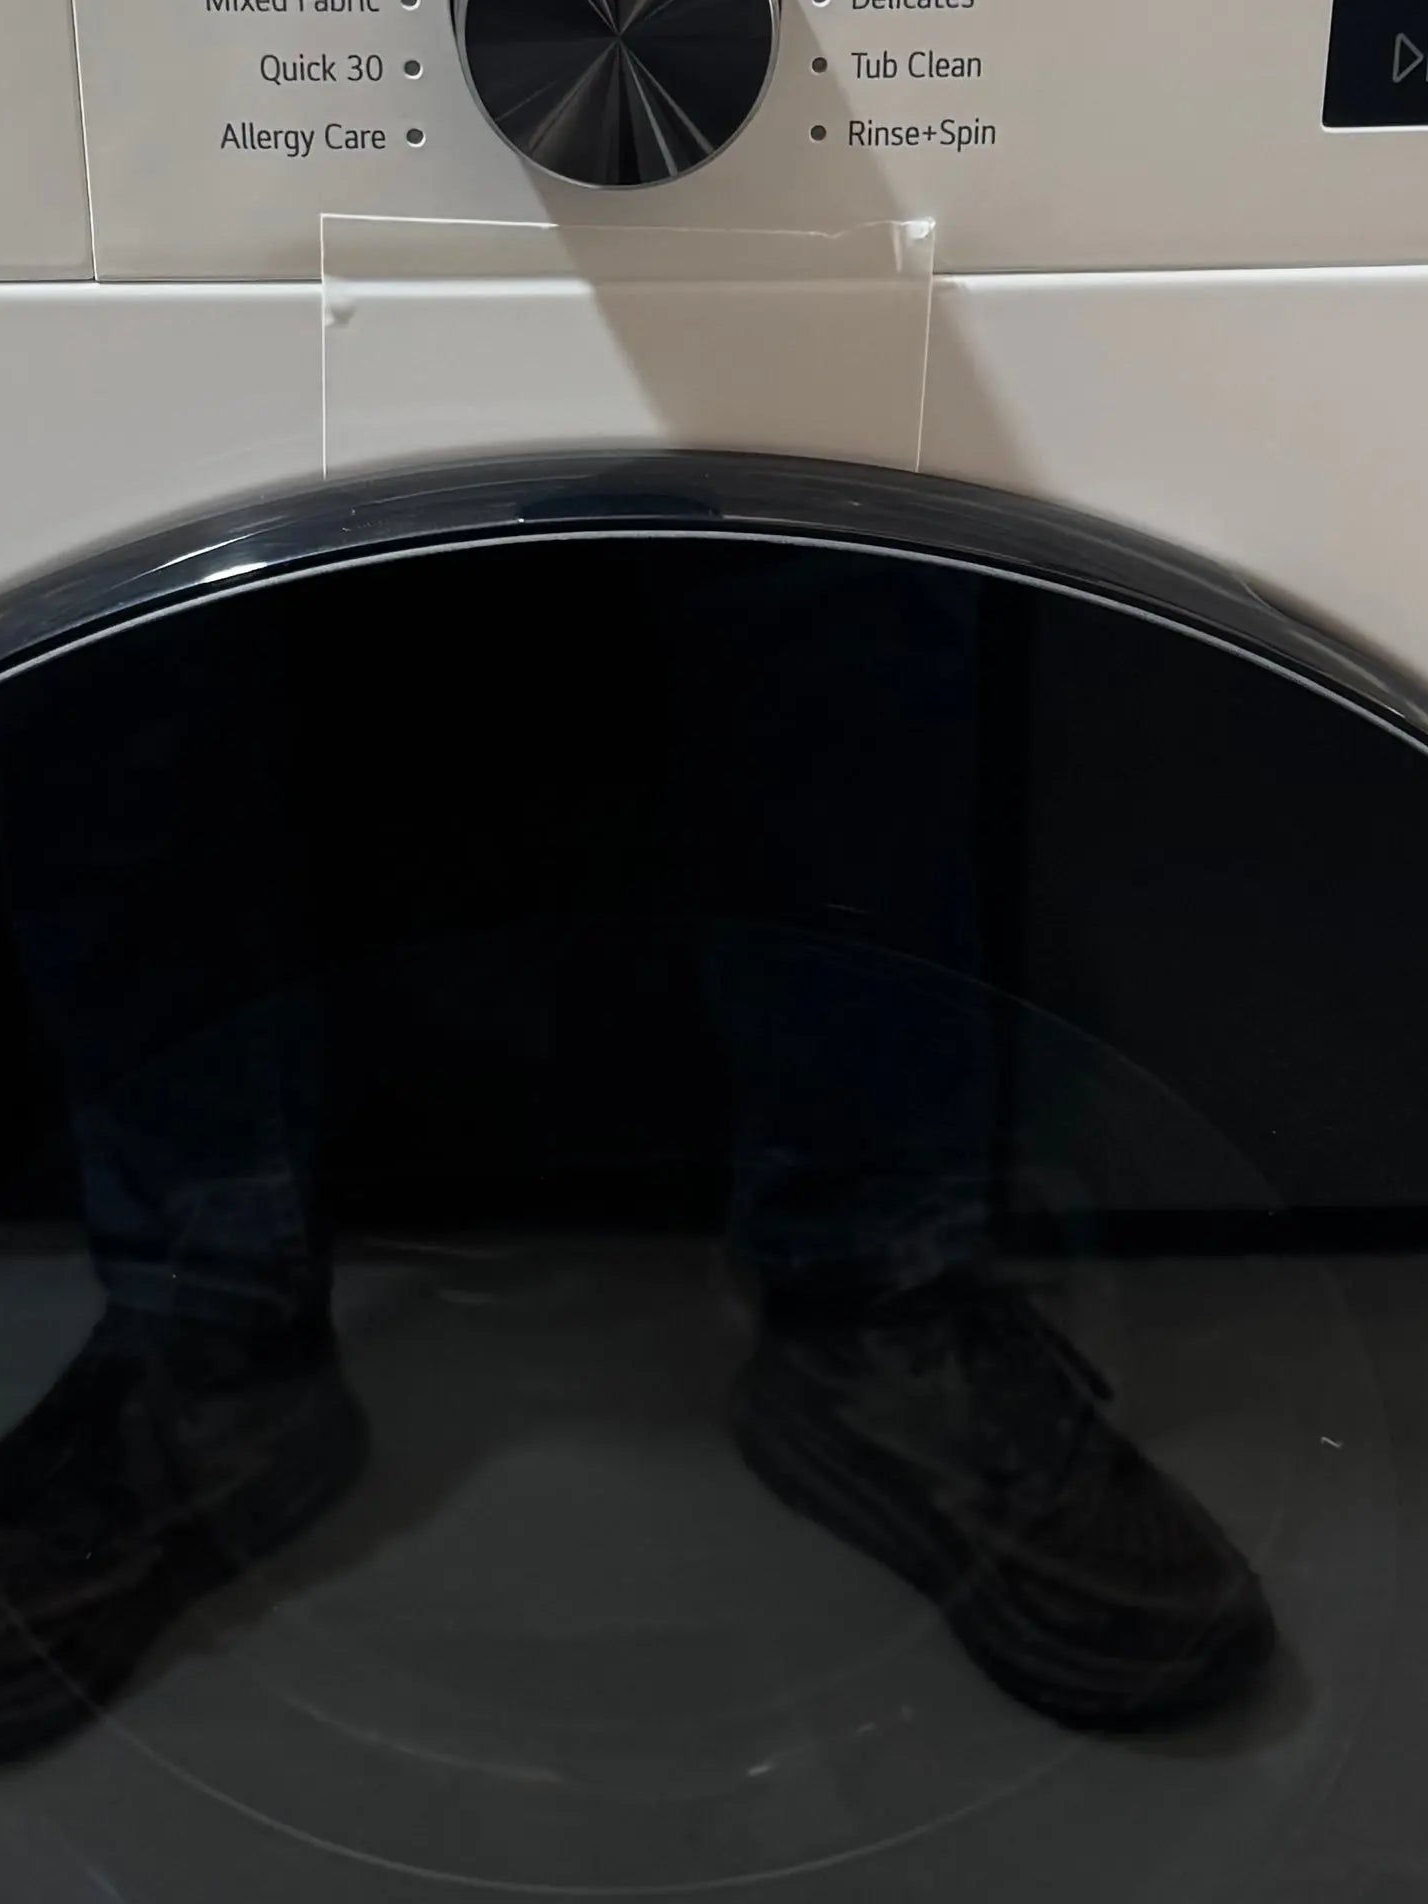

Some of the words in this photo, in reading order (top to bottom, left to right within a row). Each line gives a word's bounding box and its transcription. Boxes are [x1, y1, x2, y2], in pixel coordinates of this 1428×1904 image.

[260, 54, 337, 85] Quick
[347, 54, 383, 82] 30
[852, 51, 899, 80] Tub
[906, 51, 983, 80] Clean
[221, 123, 315, 158] Allergy
[325, 123, 386, 150] Care
[847, 119, 997, 152] Rinse+Spin
